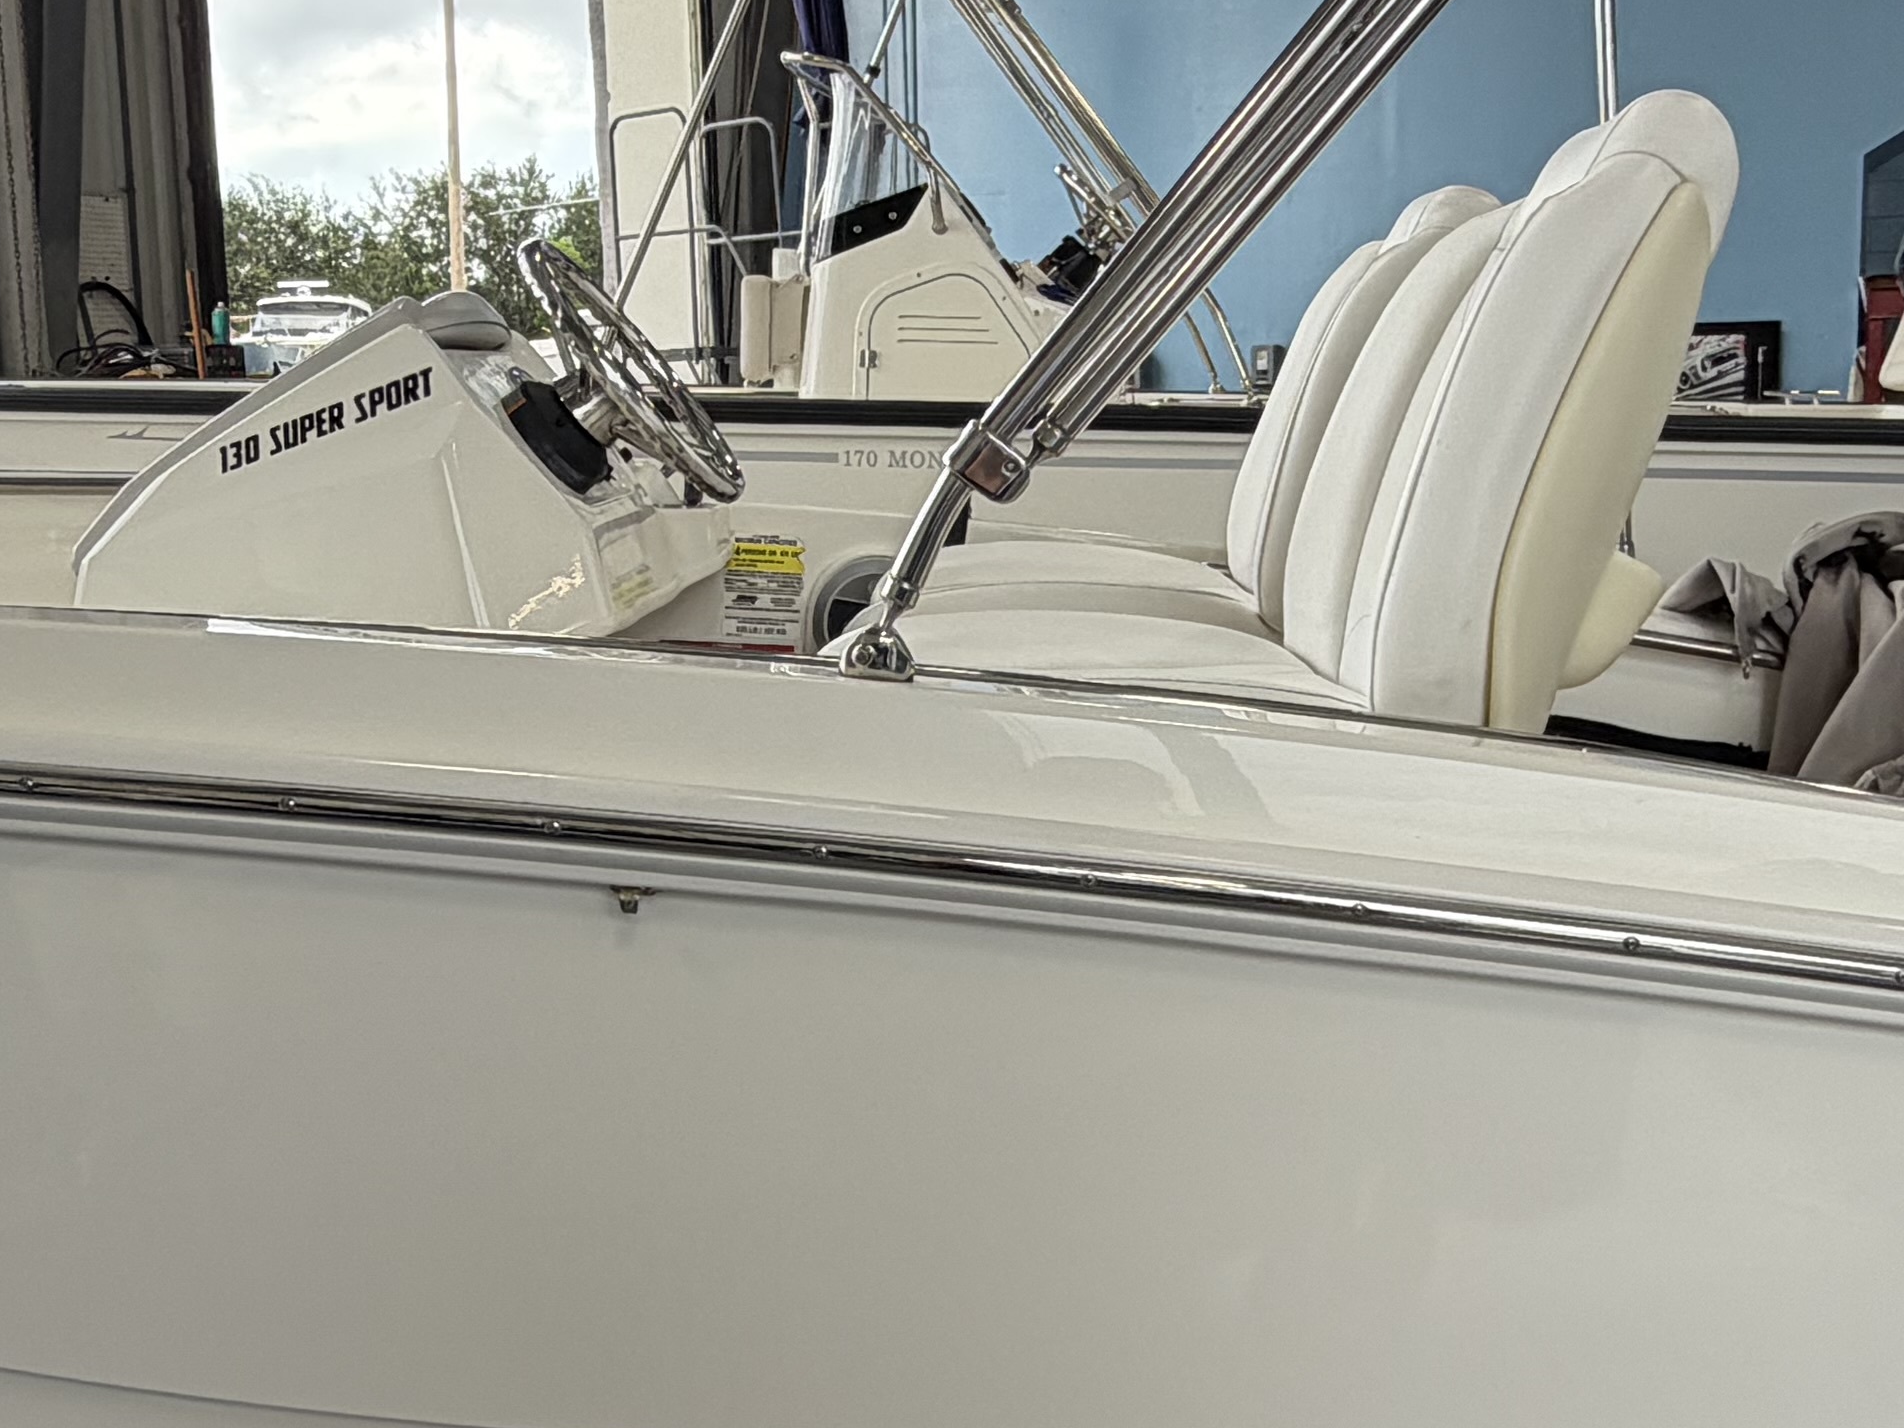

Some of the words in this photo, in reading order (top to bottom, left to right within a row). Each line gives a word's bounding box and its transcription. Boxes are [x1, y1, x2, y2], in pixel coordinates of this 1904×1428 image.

[218, 433, 260, 474] 130
[269, 401, 345, 456] SUPER
[353, 366, 434, 423] SPORT
[843, 450, 878, 468] 170
[887, 450, 944, 470] MON
